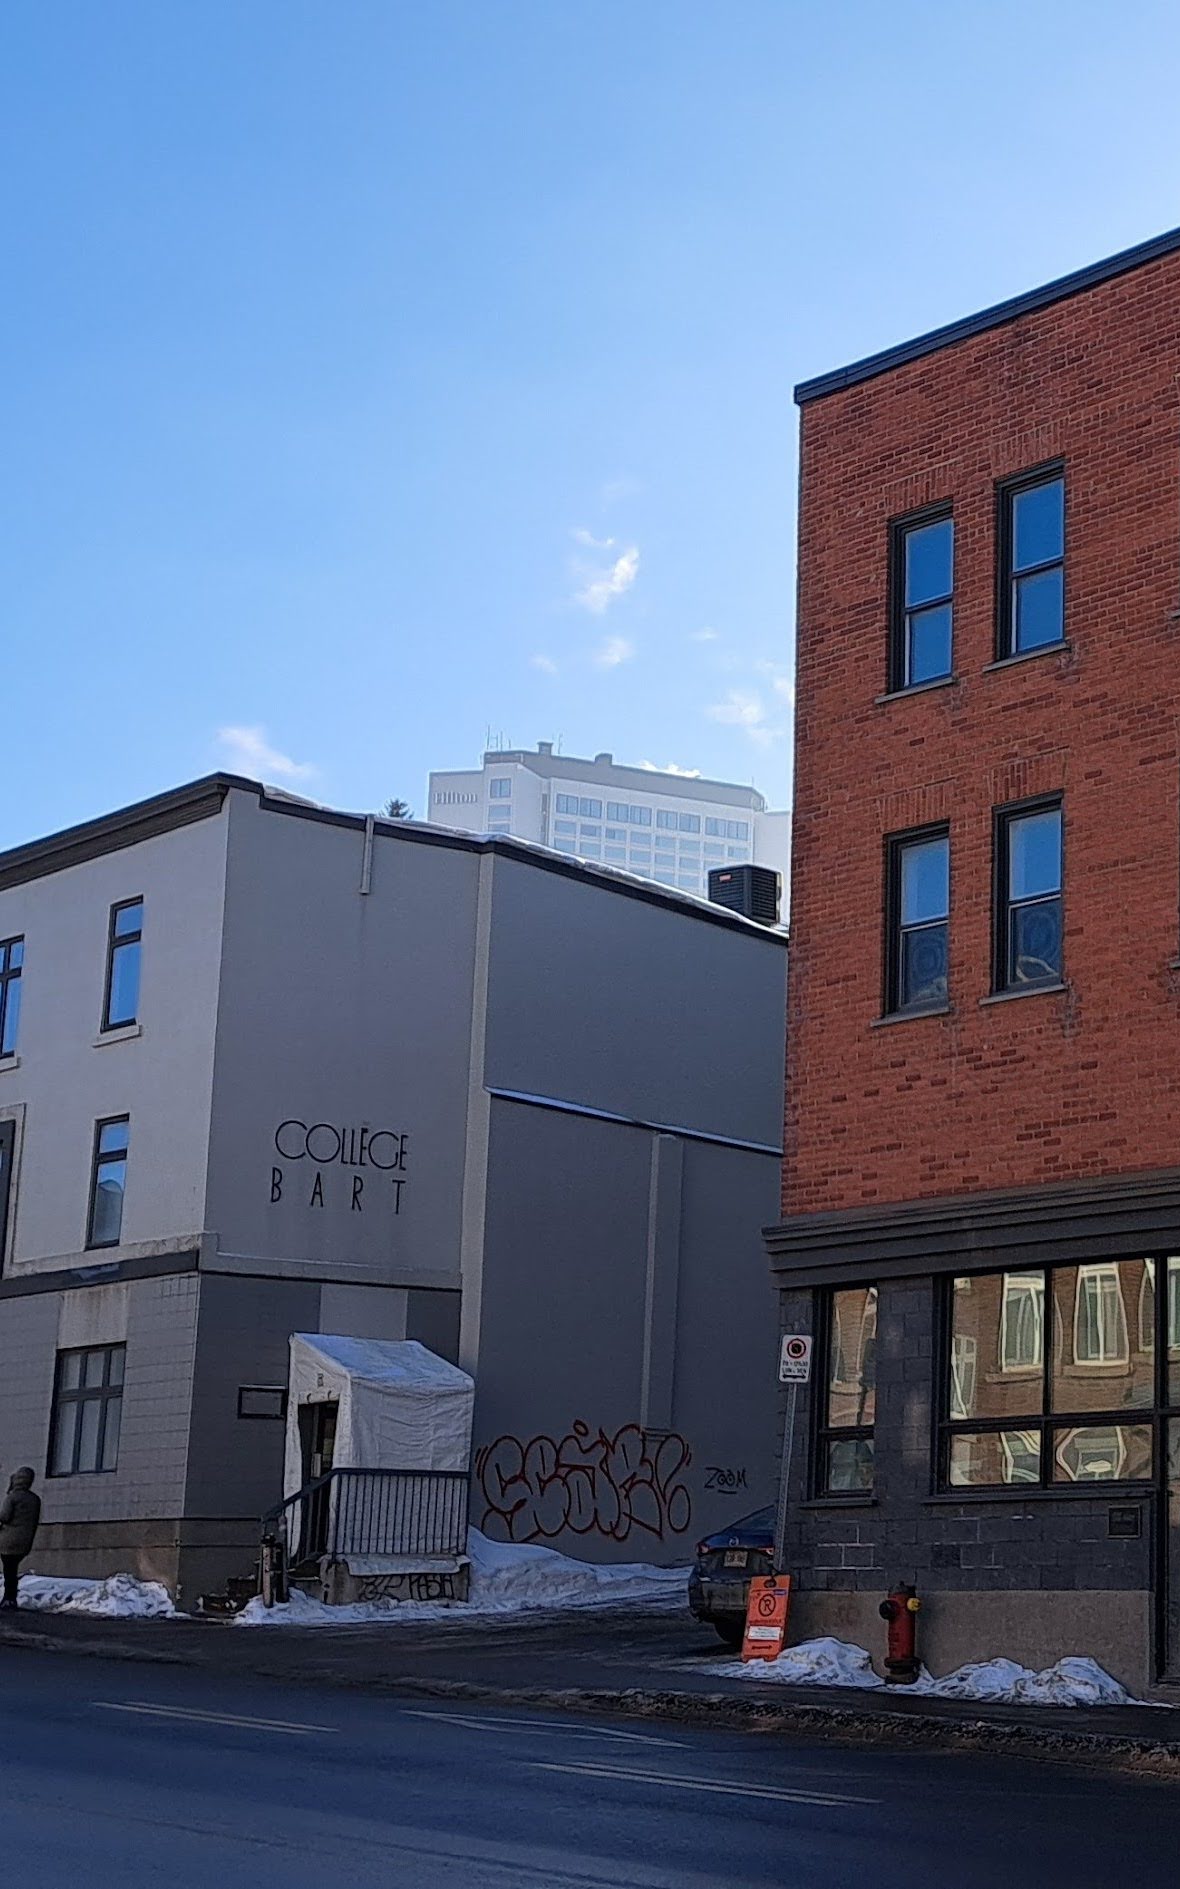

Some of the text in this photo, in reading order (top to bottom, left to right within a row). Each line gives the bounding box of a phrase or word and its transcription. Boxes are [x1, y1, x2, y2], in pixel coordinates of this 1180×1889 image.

[434, 791, 478, 805] Hilton
[270, 1166, 407, 1215] BART
[704, 1466, 749, 1490] ZOOM
